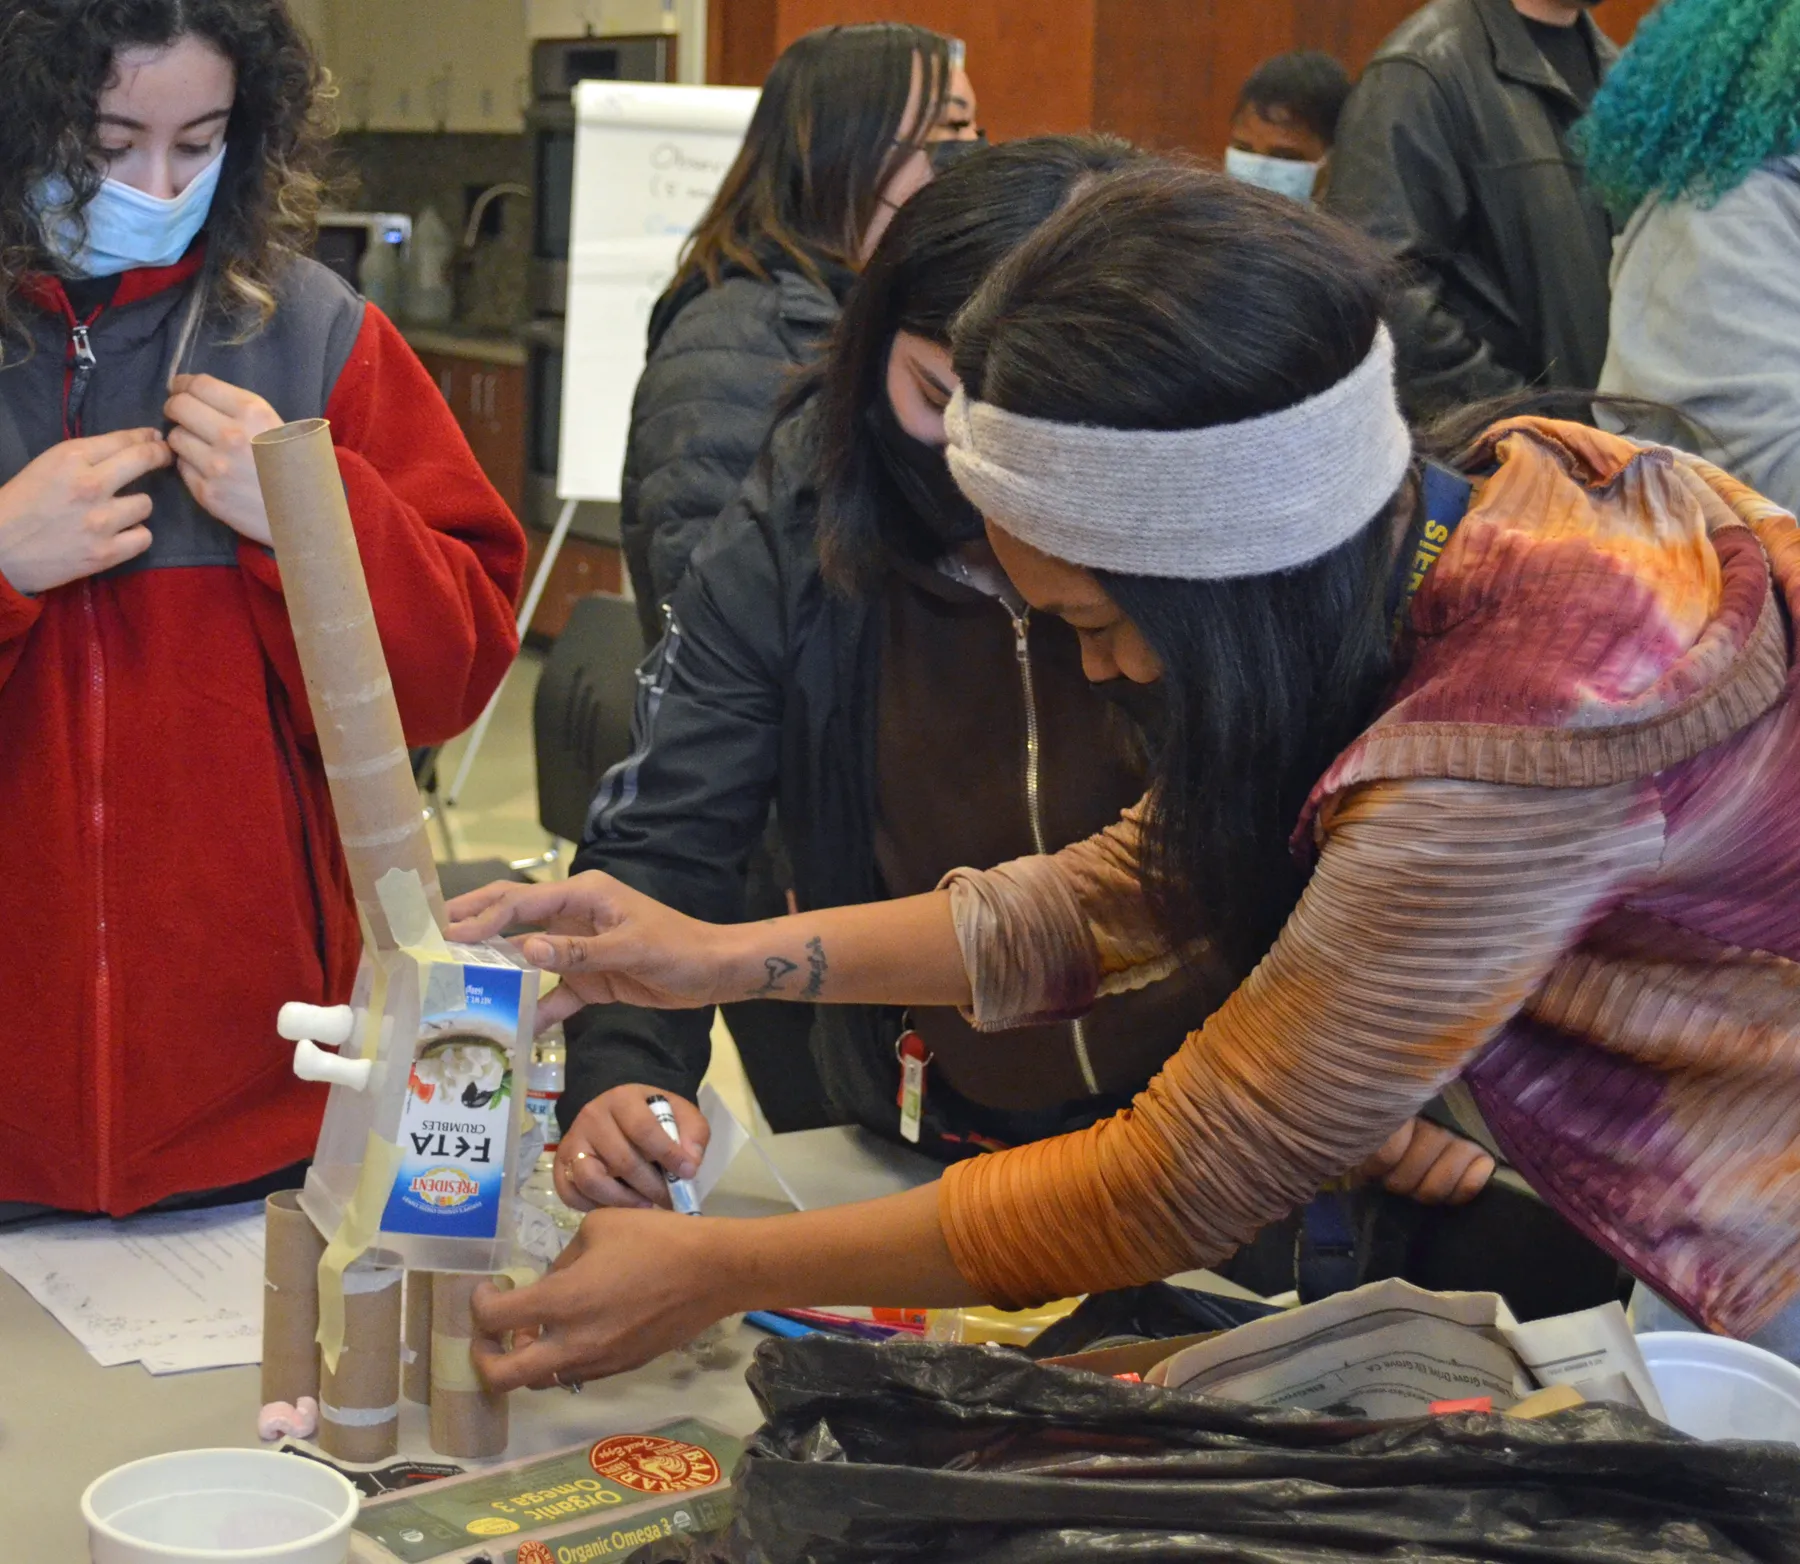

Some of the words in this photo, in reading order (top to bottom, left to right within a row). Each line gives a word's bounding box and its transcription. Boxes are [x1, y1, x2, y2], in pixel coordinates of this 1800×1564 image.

[421, 1120, 486, 1135] CRUMBLES
[410, 1132, 491, 1163] FETA
[620, 1449, 711, 1492] BARNSTAR
[490, 1501, 513, 1513] 3
[509, 1479, 602, 1508] Omega
[523, 1490, 622, 1522] Organic
[557, 1536, 612, 1564] Organic
[611, 1525, 662, 1550] Omega
[660, 1517, 672, 1536] 3
